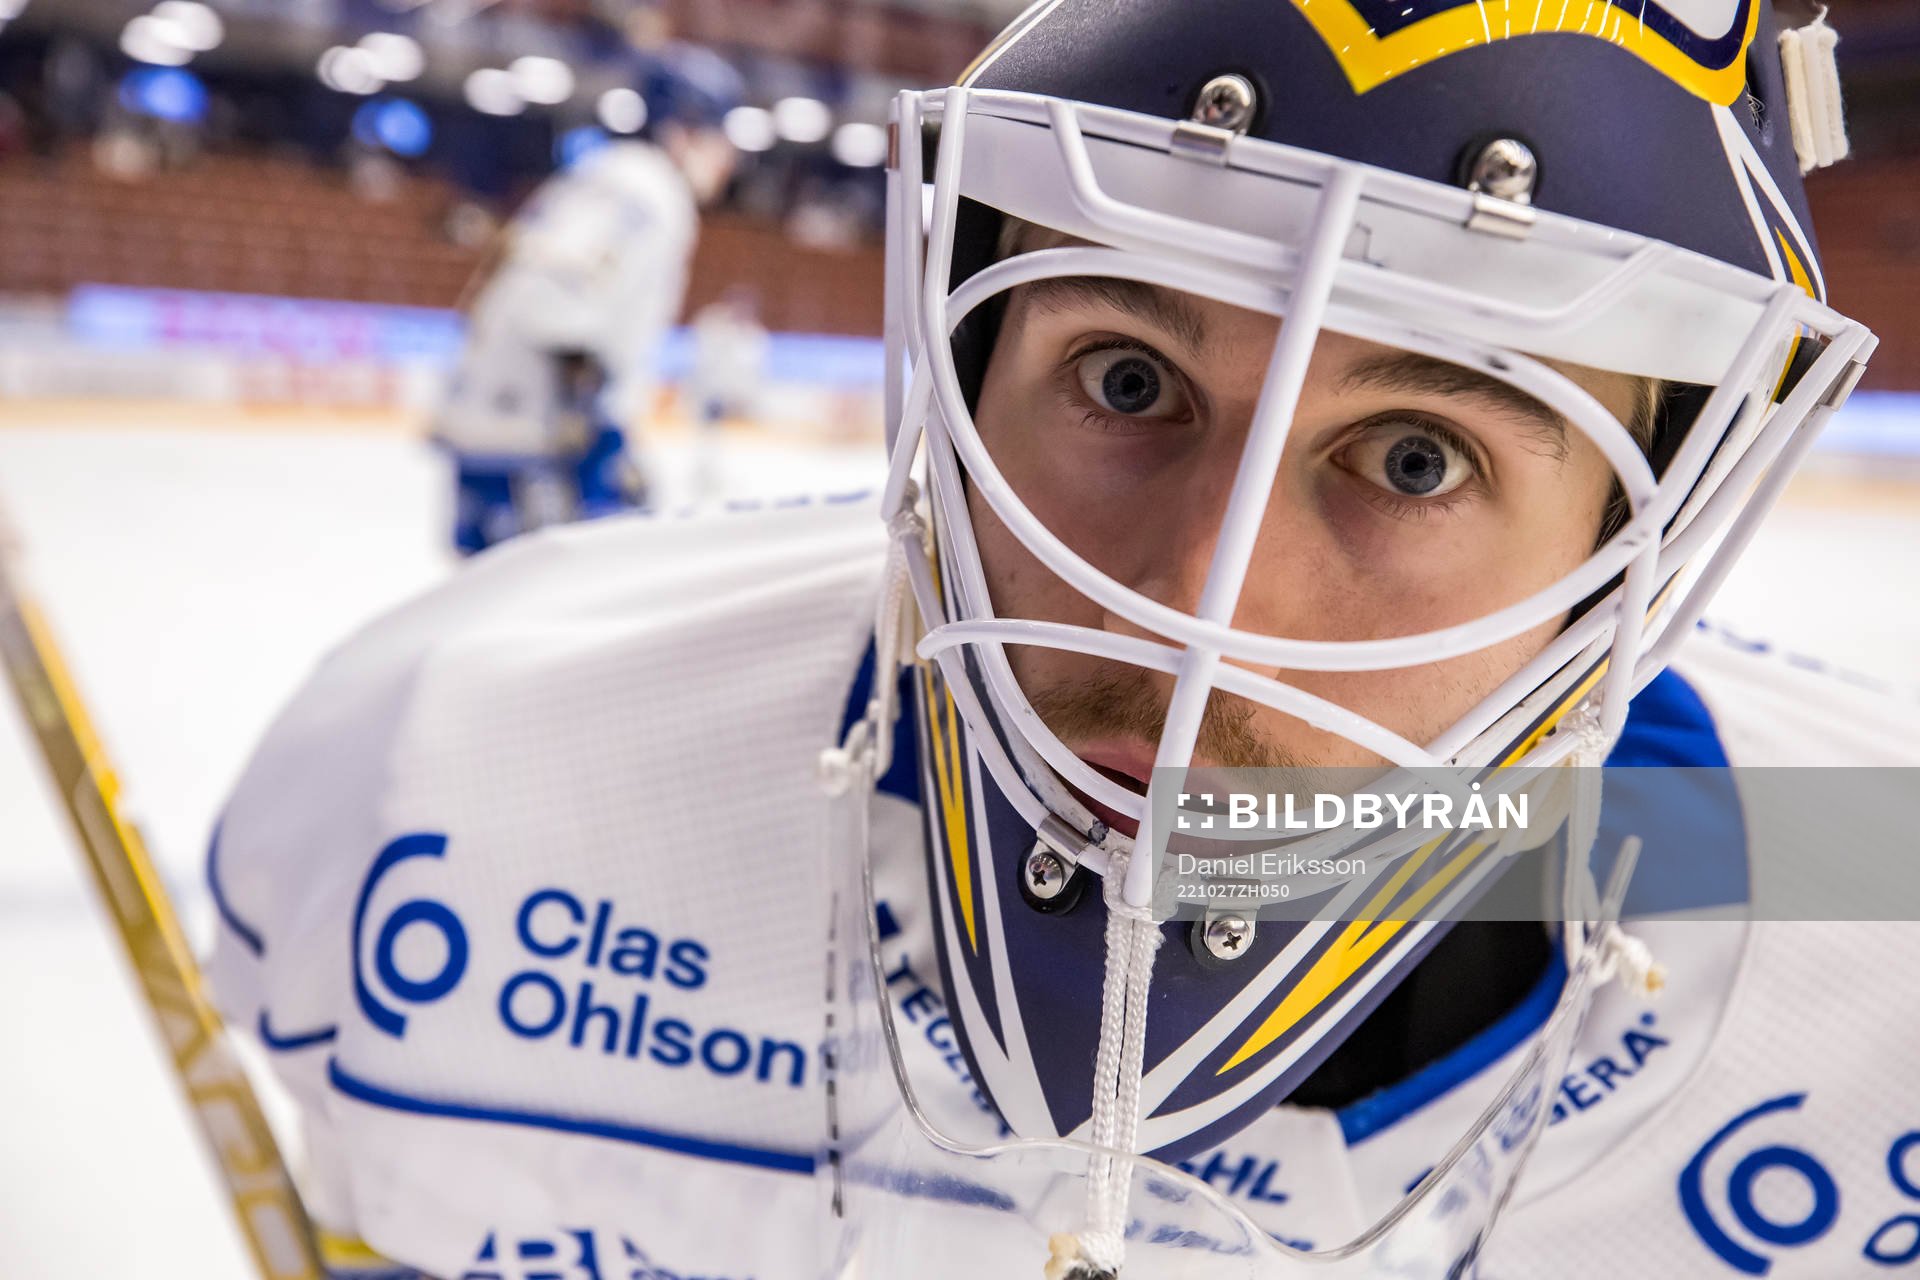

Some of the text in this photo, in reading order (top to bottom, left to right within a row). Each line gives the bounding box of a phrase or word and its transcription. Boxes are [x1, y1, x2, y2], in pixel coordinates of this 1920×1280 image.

[516, 887, 711, 991] Clas
[496, 970, 807, 1087] Ohlson
[1178, 1152, 1290, 1204] HL
